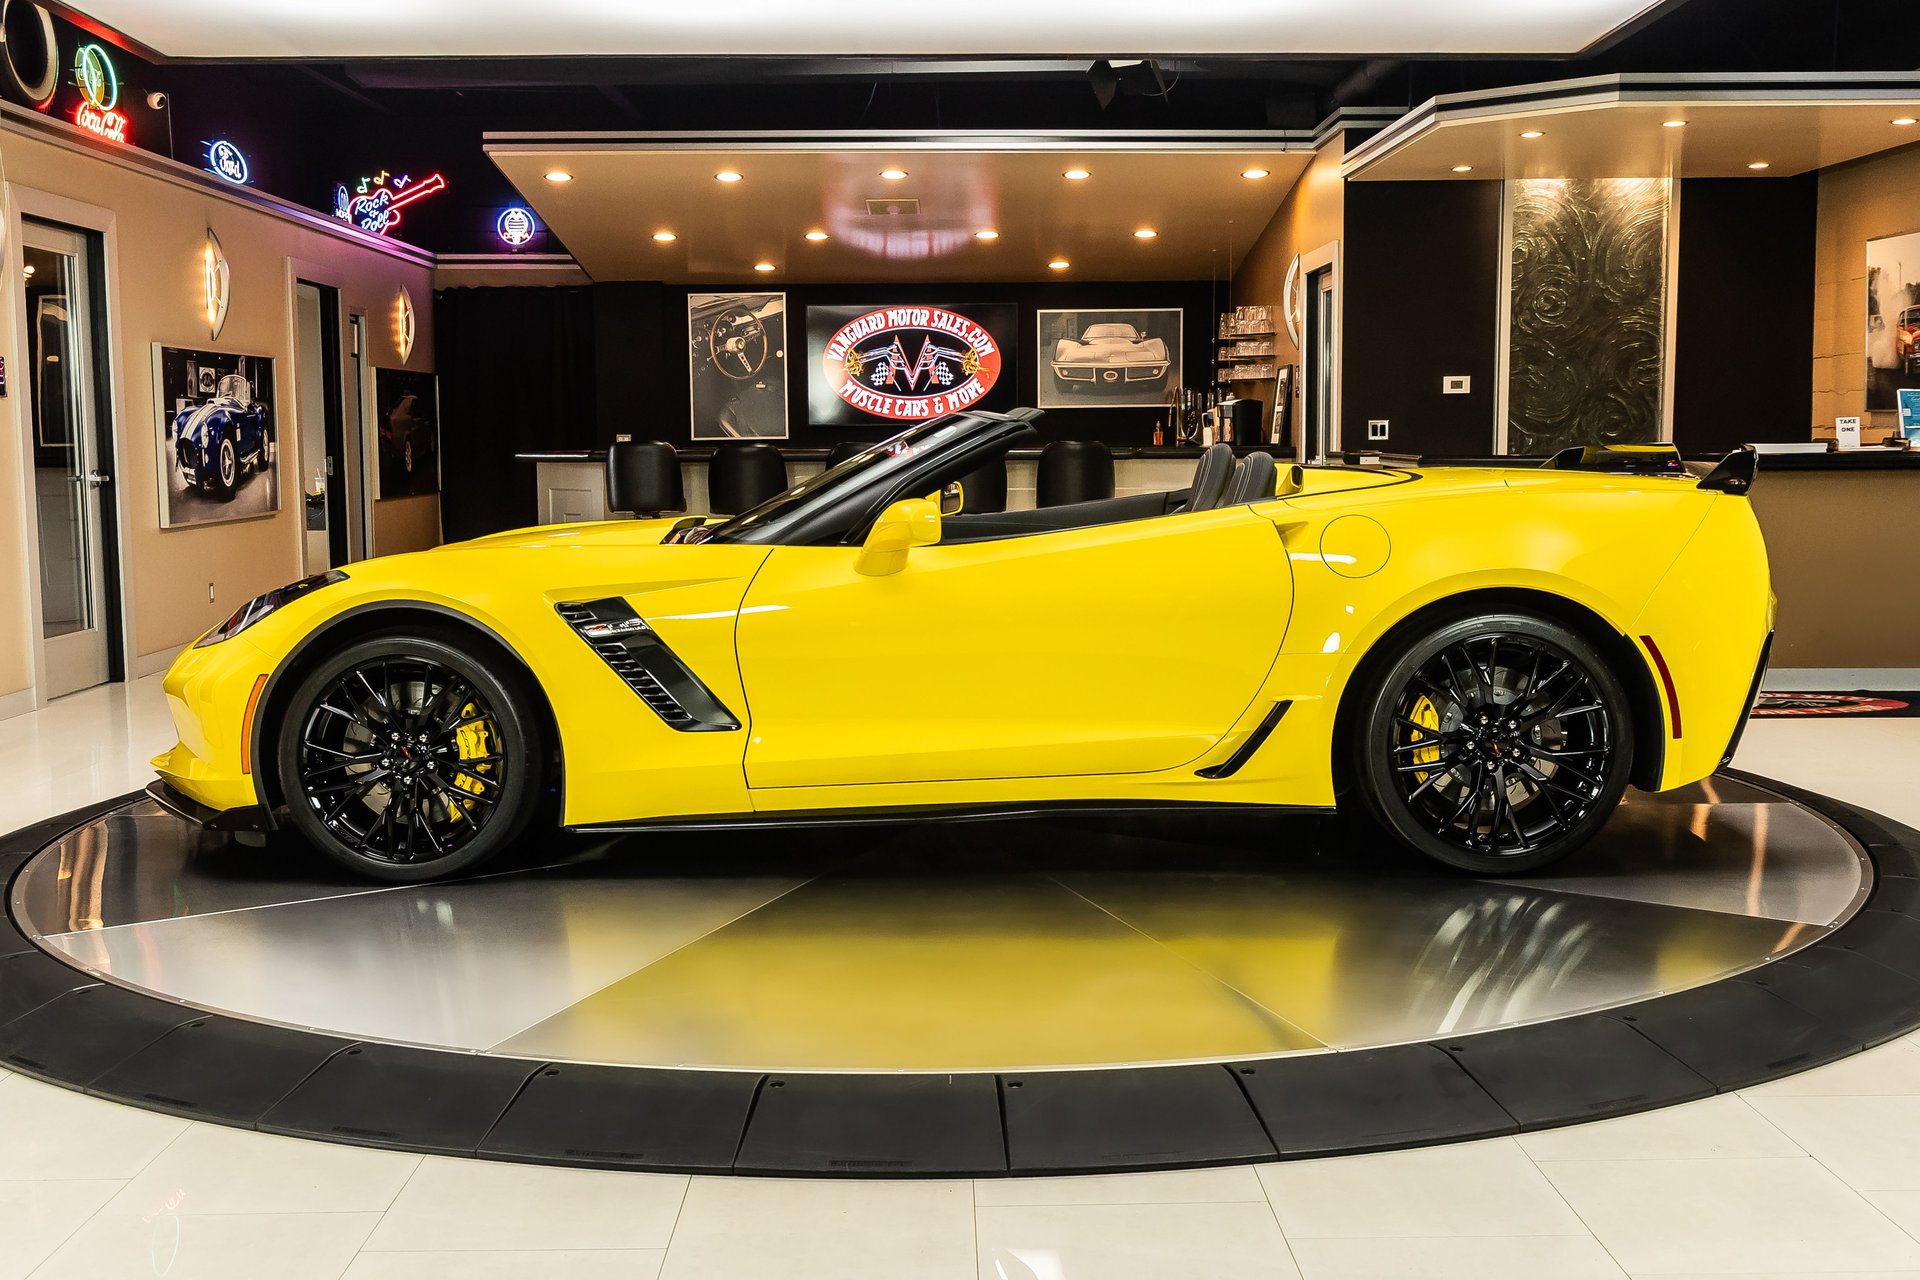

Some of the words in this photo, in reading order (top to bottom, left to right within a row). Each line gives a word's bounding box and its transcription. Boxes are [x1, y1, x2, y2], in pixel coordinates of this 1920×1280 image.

[218, 144, 242, 179] Ford
[354, 191, 389, 215] Rock
[827, 311, 885, 361] VANGUARD
[886, 308, 930, 327] MOTOR
[931, 310, 995, 357] SALES.COM
[839, 380, 893, 415] MUSCLE
[894, 399, 929, 417] CARS
[933, 397, 944, 414] &
[945, 378, 986, 411] MORE
